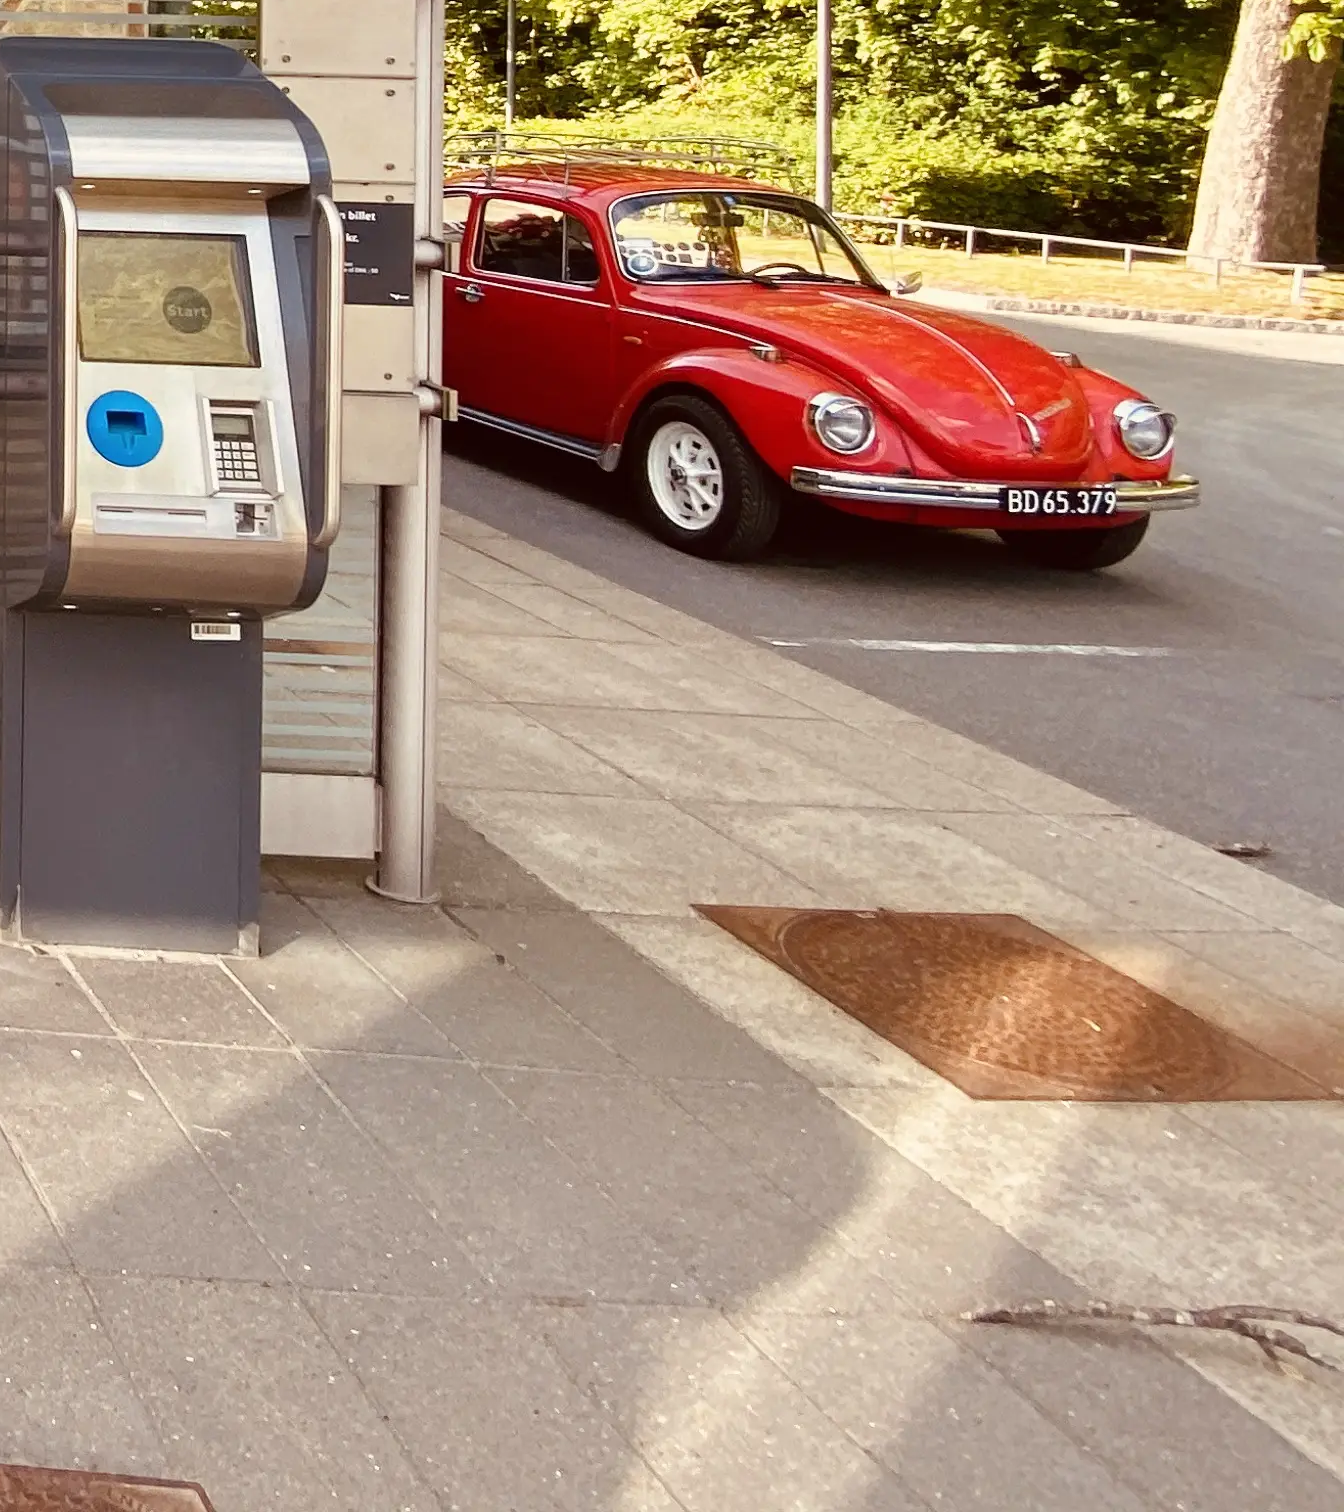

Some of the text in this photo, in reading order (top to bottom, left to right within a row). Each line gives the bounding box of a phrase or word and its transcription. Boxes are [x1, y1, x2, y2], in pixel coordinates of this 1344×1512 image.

[348, 210, 377, 221] billet
[166, 303, 207, 319] Start
[1007, 489, 1117, 514] BD 65.379
